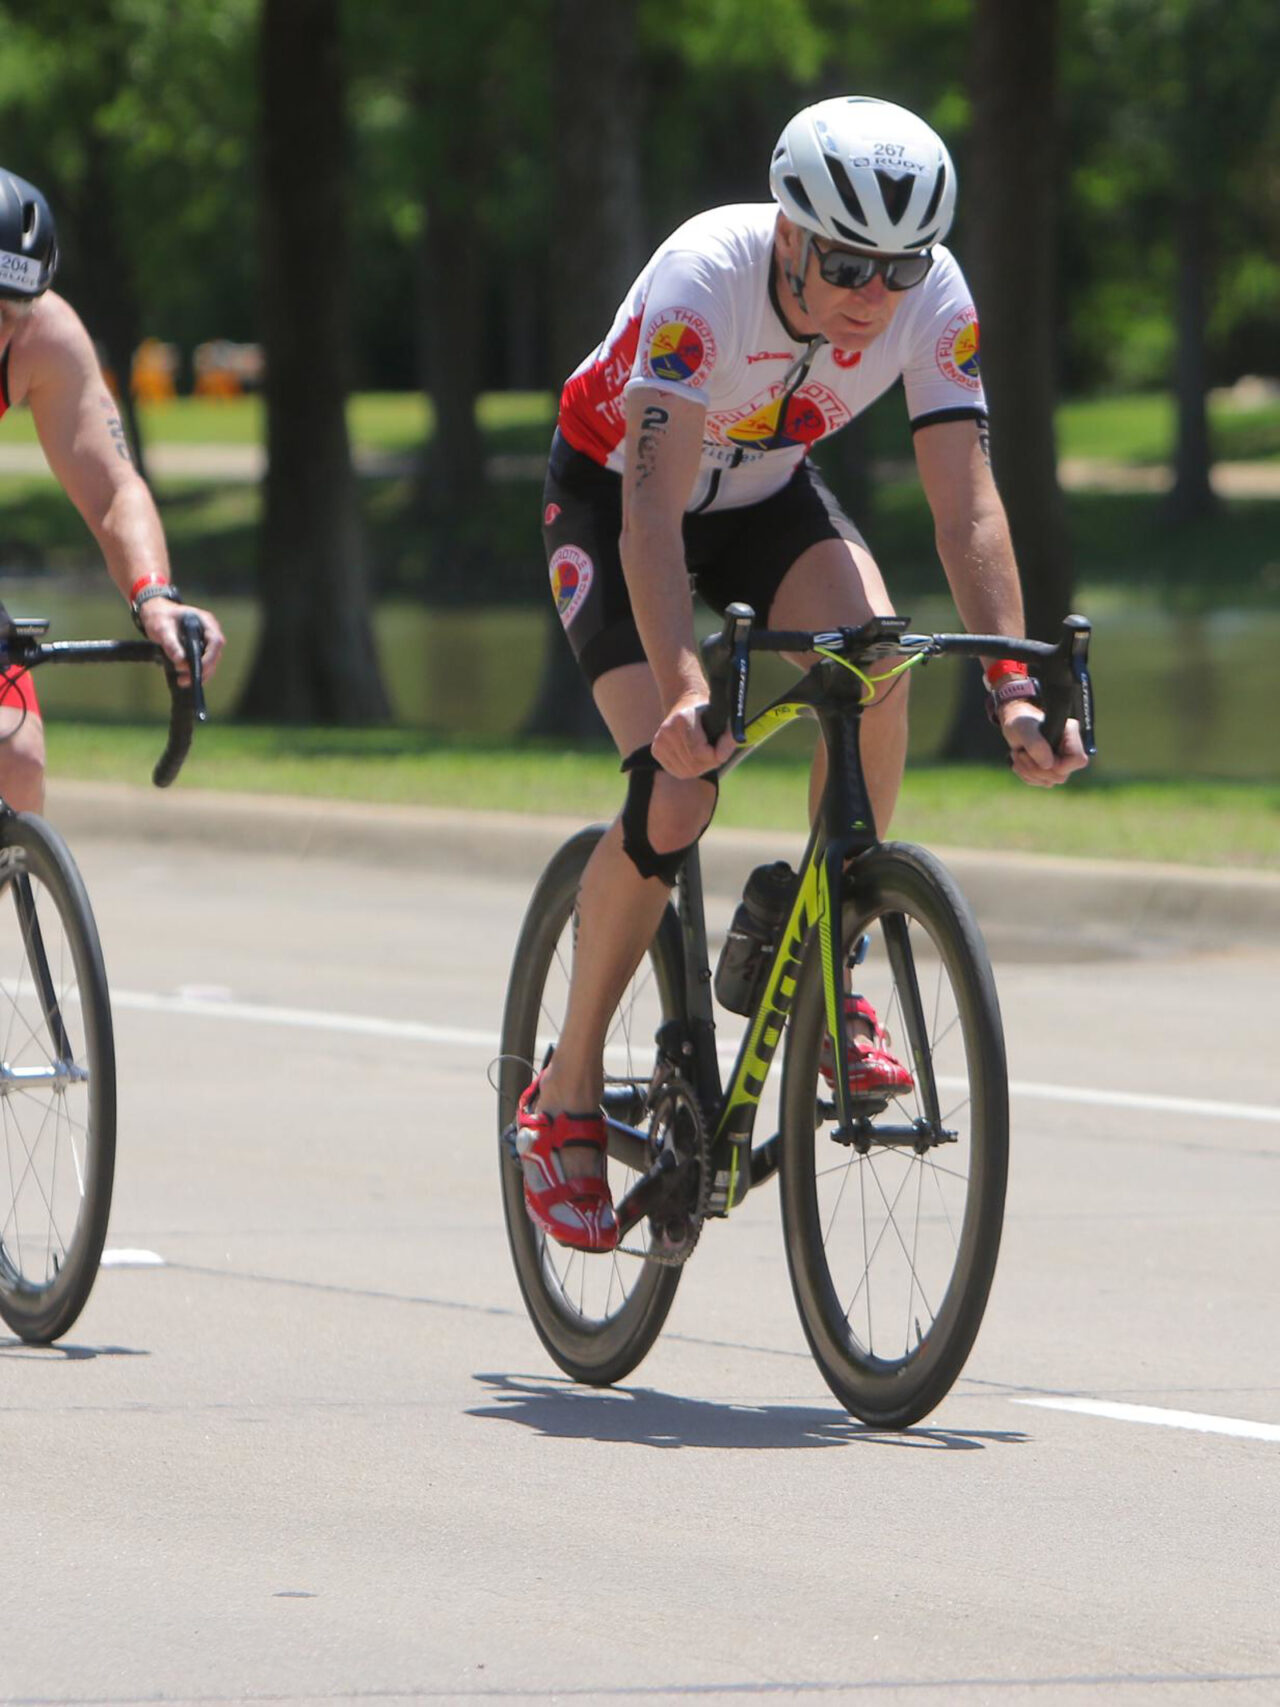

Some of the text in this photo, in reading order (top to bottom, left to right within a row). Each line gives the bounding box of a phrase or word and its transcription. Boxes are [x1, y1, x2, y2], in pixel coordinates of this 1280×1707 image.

[873, 143, 905, 157] 267
[874, 157, 926, 171] RUDY
[1, 254, 29, 274] 204
